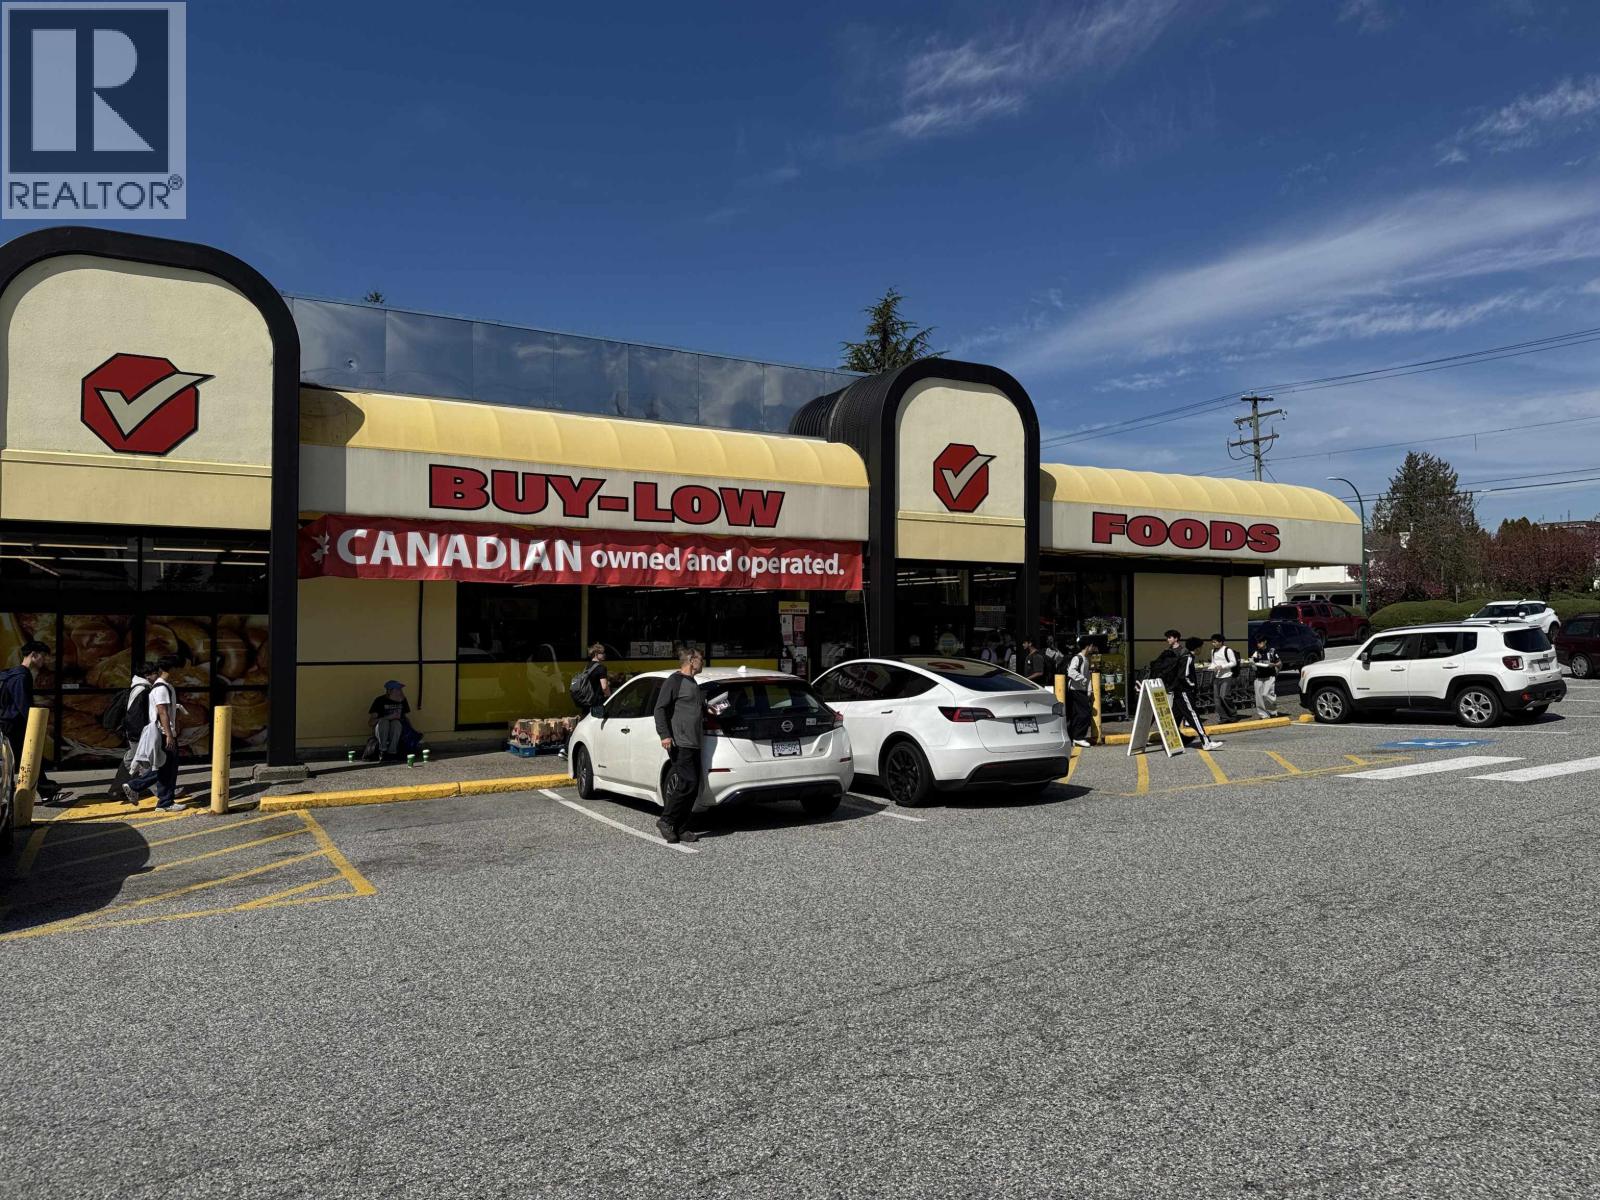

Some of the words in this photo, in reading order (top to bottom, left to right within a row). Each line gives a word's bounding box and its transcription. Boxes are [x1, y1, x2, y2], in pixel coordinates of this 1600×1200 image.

[428, 464, 785, 528] BUY-LOW
[336, 528, 582, 572] CANADIAN
[591, 547, 680, 572] owned
[687, 549, 733, 574] and
[738, 550, 845, 579] operated.
[1092, 512, 1280, 552] FOODS
